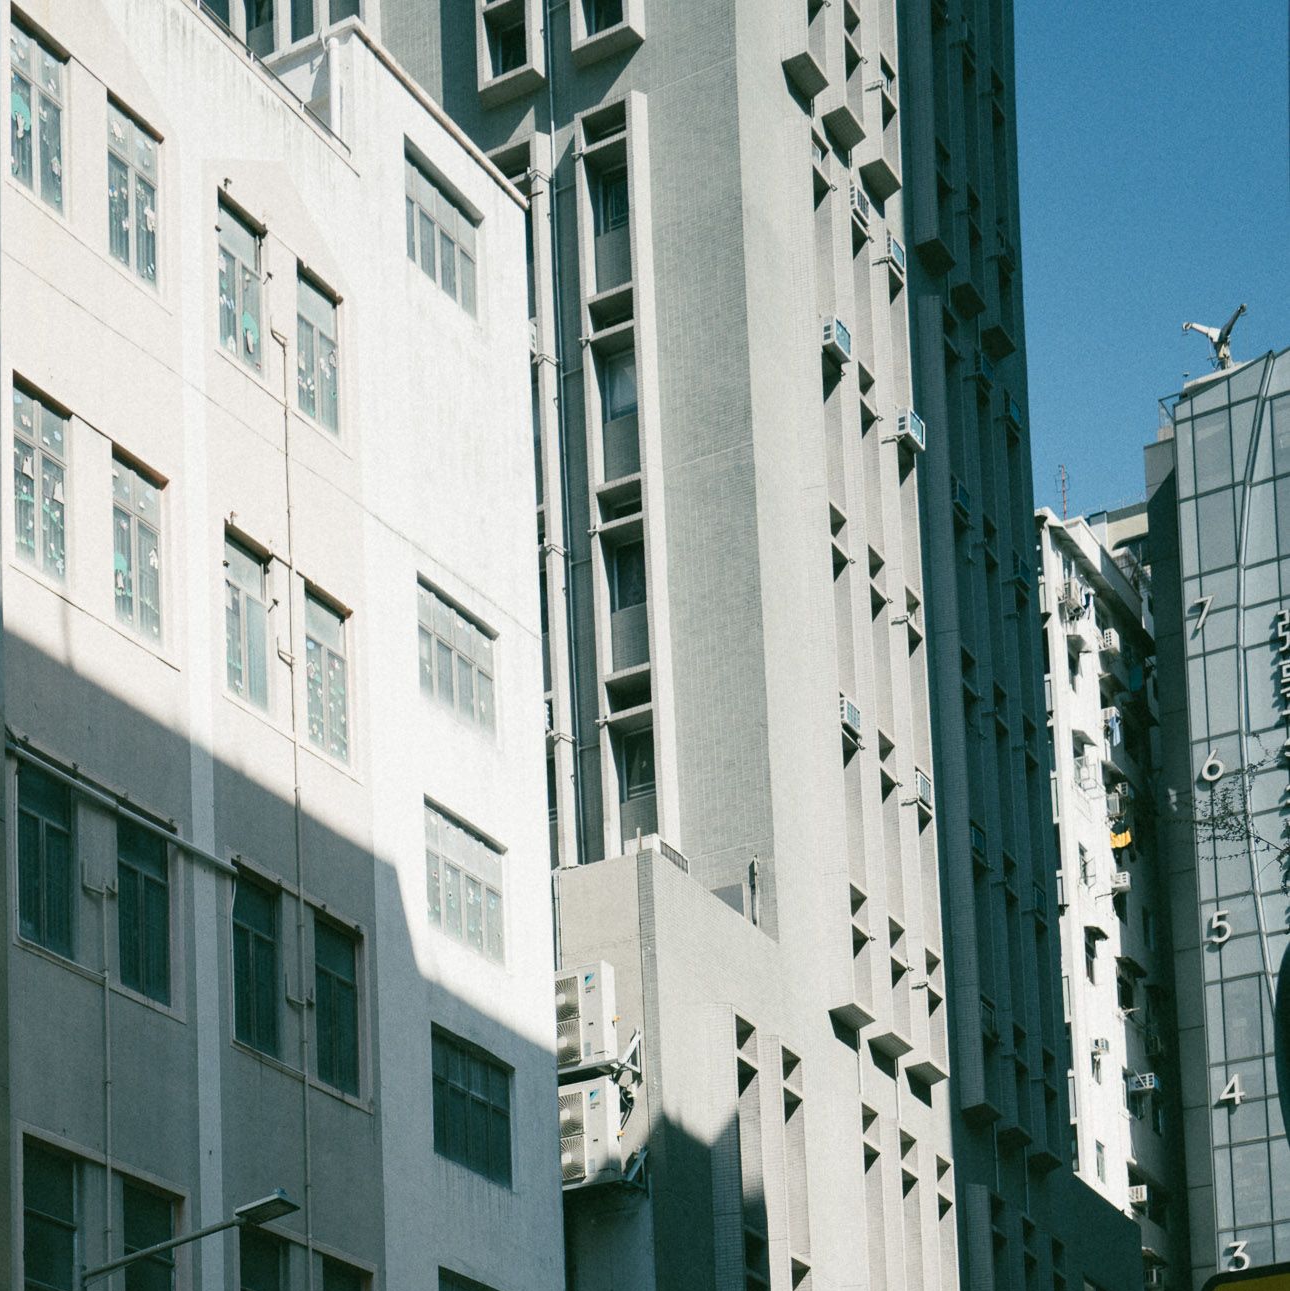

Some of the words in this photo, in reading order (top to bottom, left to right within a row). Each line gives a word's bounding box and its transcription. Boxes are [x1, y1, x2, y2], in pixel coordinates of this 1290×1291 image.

[1194, 594, 1214, 629] 7
[1201, 749, 1224, 781] 6
[1211, 909, 1232, 943] 5
[1220, 1073, 1246, 1105] 4
[1228, 1240, 1251, 1272] 3
